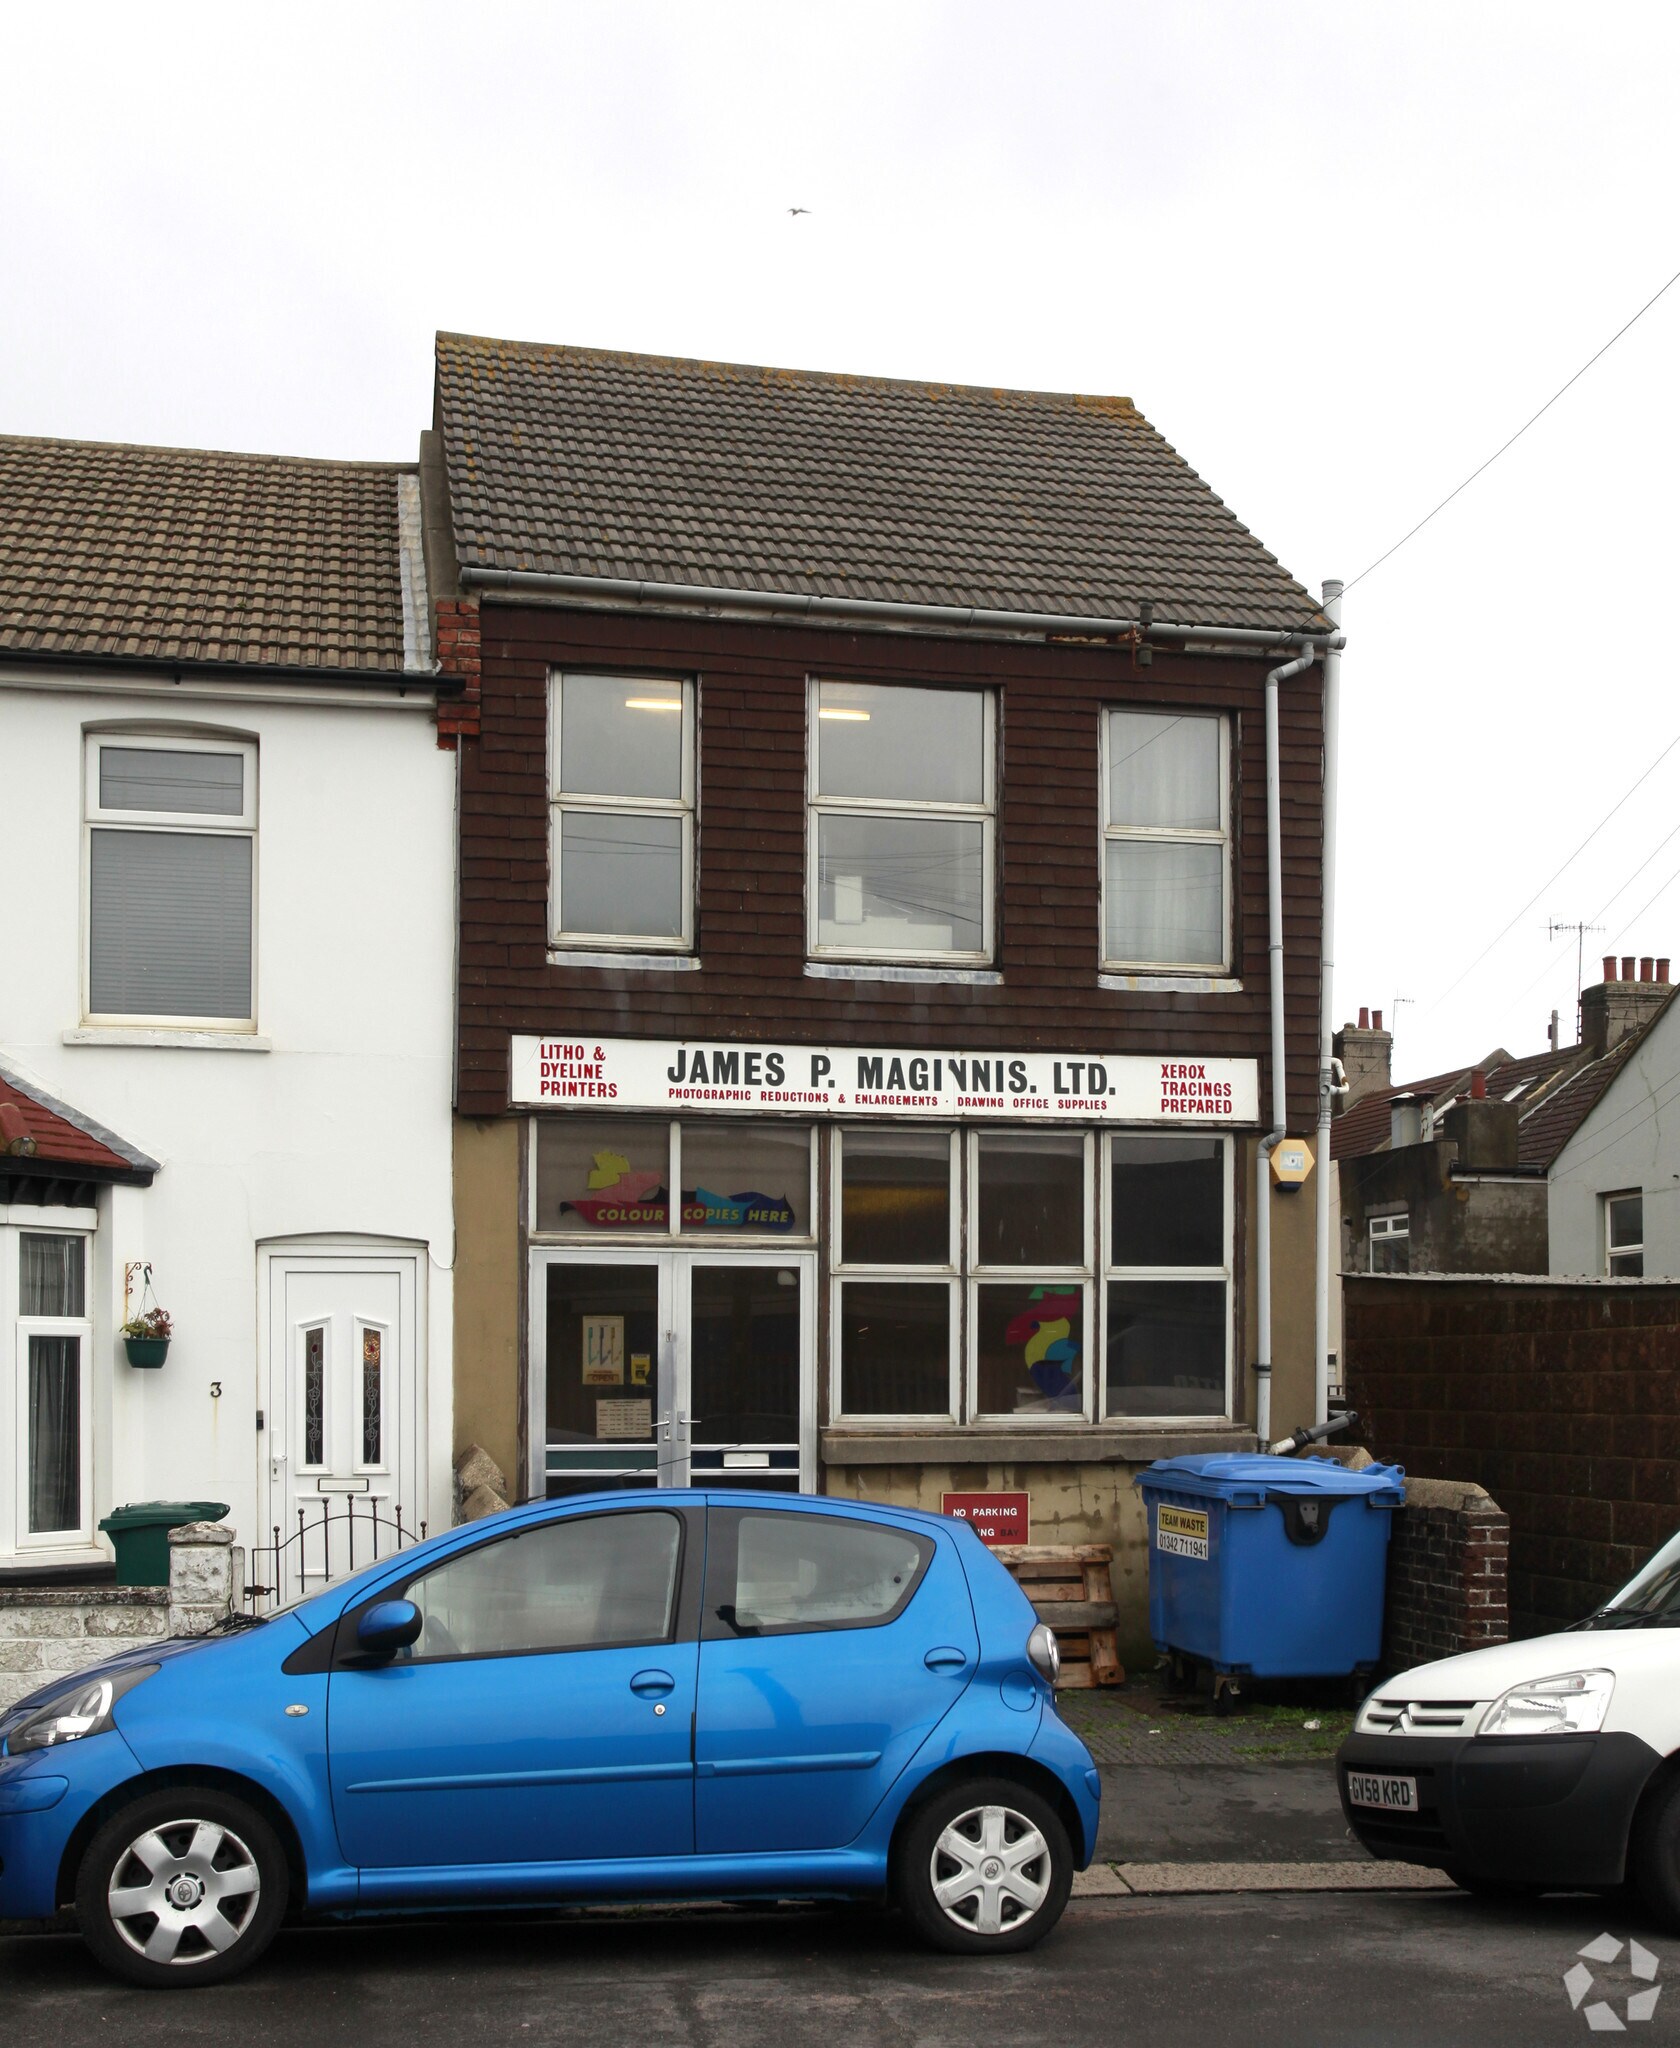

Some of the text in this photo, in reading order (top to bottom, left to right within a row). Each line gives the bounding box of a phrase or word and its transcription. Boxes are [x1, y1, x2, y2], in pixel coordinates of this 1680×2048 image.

[540, 1044, 606, 1061] LITHO &
[540, 1062, 603, 1079] DYELINE
[667, 1049, 785, 1087] JAMES
[811, 1054, 836, 1088] P.
[1053, 1061, 1116, 1096] LTD.
[1160, 1064, 1206, 1079] XEROX
[540, 1081, 618, 1098] PRINTERS
[1161, 1081, 1232, 1097] TRACINGS
[668, 1088, 1107, 1110] PHOTOGRAPHIC REDUCTIONS & ENLARGEMENTS DRAWING OFFICE SUPPLIES
[1161, 1098, 1232, 1114] PREPARED
[596, 1208, 789, 1223] COLOUR COPIES HERE
[210, 1381, 222, 1398] 3
[953, 1507, 1018, 1517] NO PARKING
[1161, 1513, 1205, 1533] TEAM WASTE
[1160, 1533, 1207, 1558] 01342 711941
[1352, 1776, 1410, 1806] GV58 KRD
